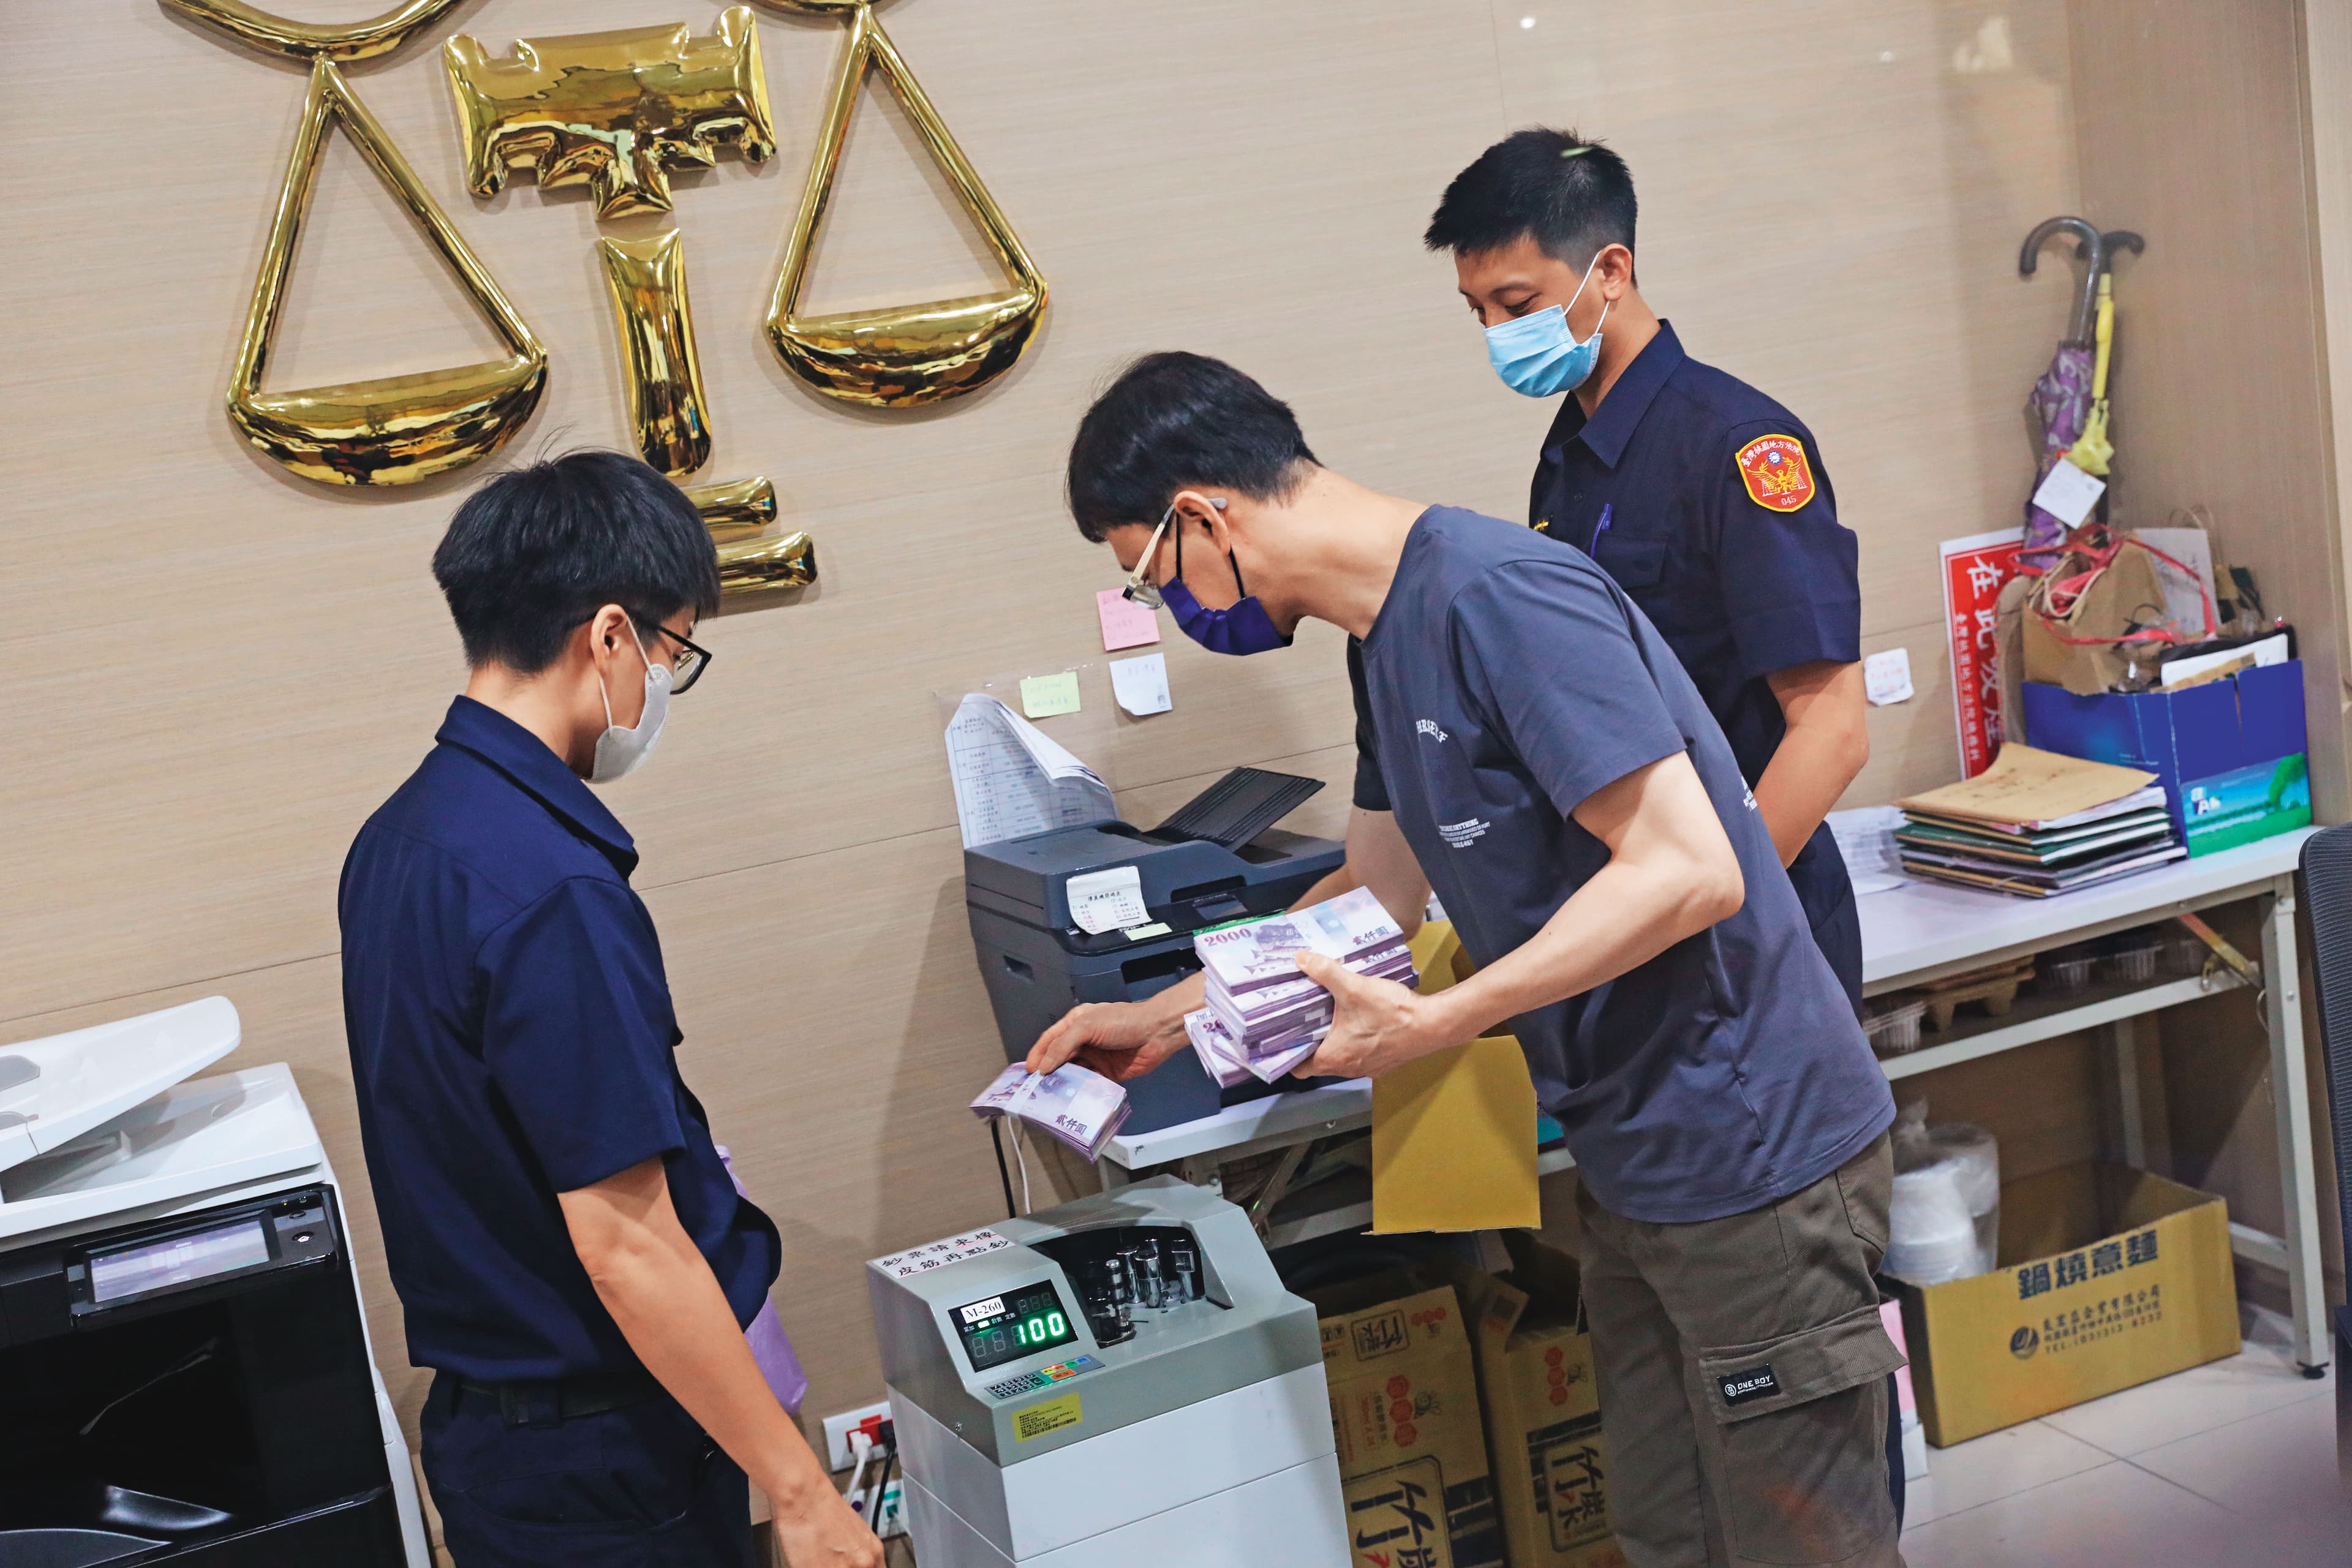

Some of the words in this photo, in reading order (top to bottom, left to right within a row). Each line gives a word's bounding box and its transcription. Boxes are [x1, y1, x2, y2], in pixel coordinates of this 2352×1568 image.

[1781, 496, 1797, 506] 045
[1204, 928, 1253, 947] 2000
[1352, 926, 1389, 946] 貳仟圓
[1055, 1114, 1088, 1136] 貳仟圓
[899, 1240, 1009, 1276] 皮筋再點鈔
[966, 1301, 1002, 1317] M-260
[1019, 1313, 1065, 1344] 100
[1738, 1380, 1754, 1390] ONE
[1754, 1375, 1770, 1385] BOY
